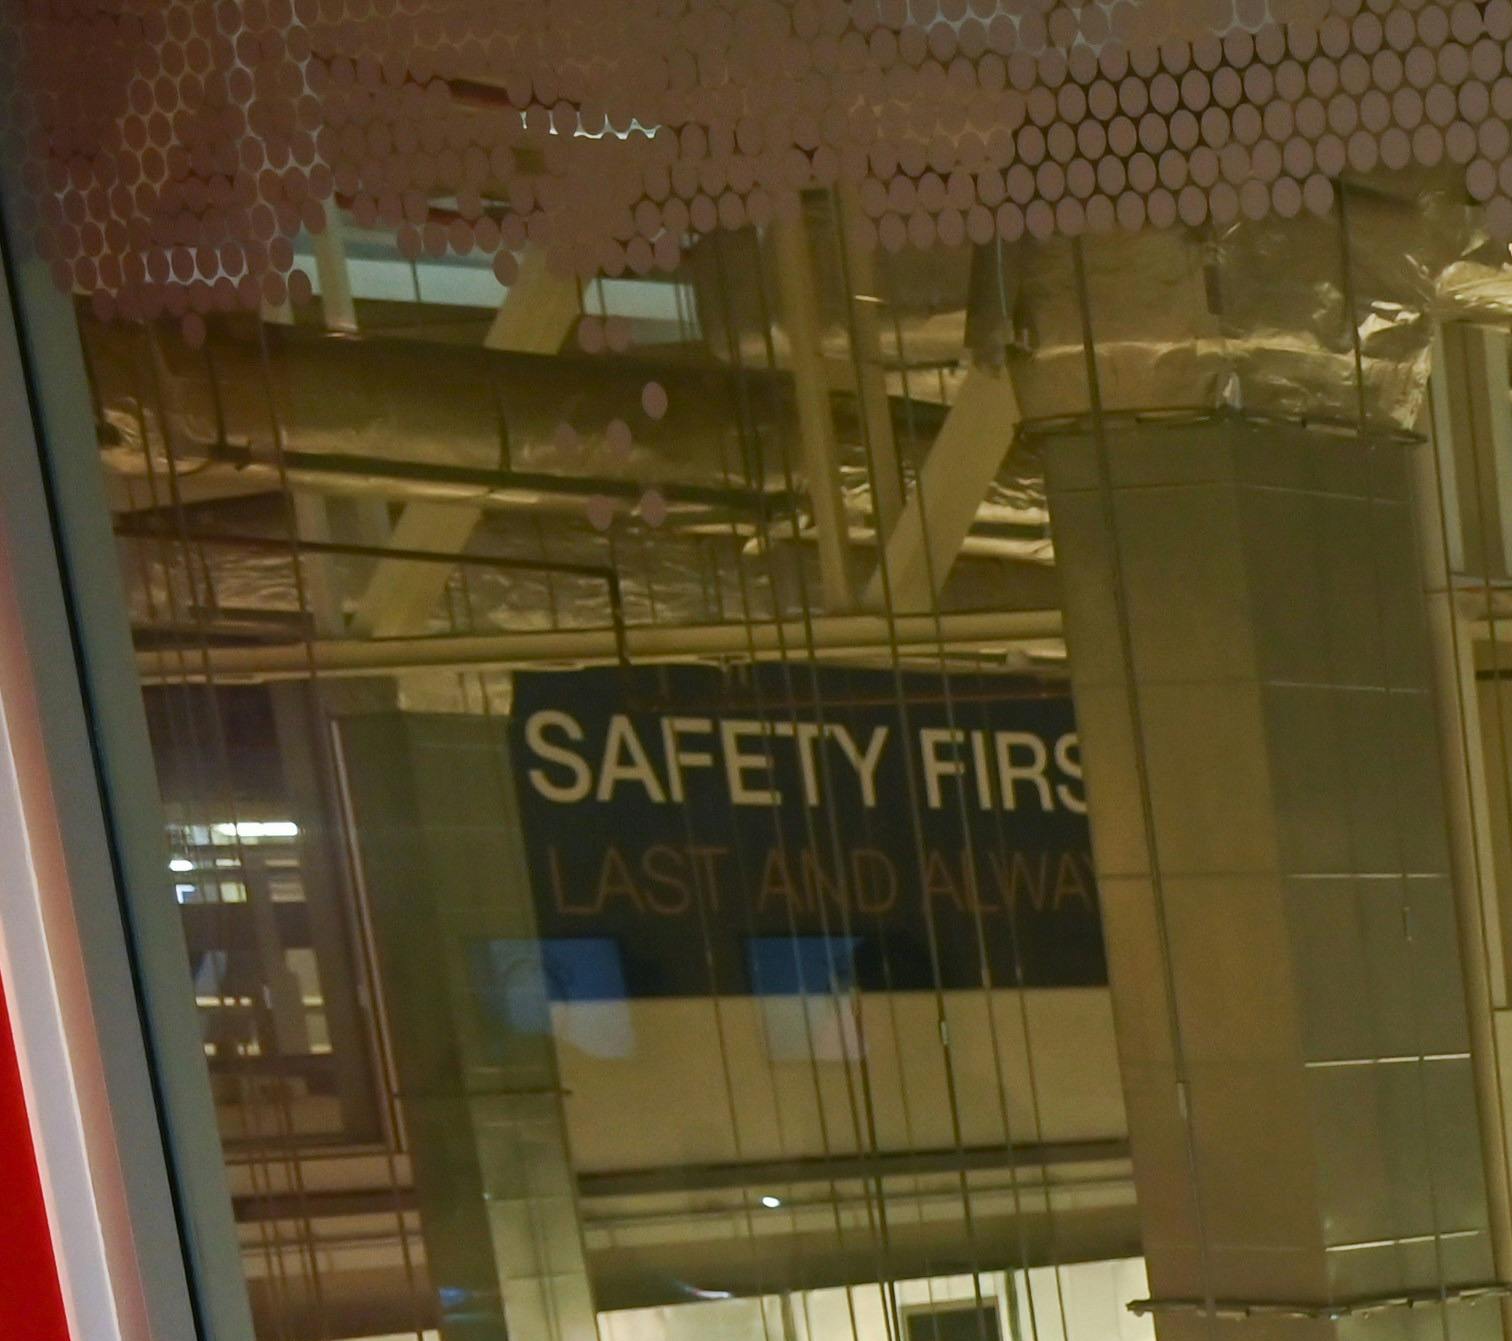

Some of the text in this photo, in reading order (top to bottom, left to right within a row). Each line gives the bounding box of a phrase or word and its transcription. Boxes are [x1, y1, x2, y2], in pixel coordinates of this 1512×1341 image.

[525, 709, 889, 808] SAFETY
[549, 844, 729, 916] LAST
[757, 845, 899, 914] AND
